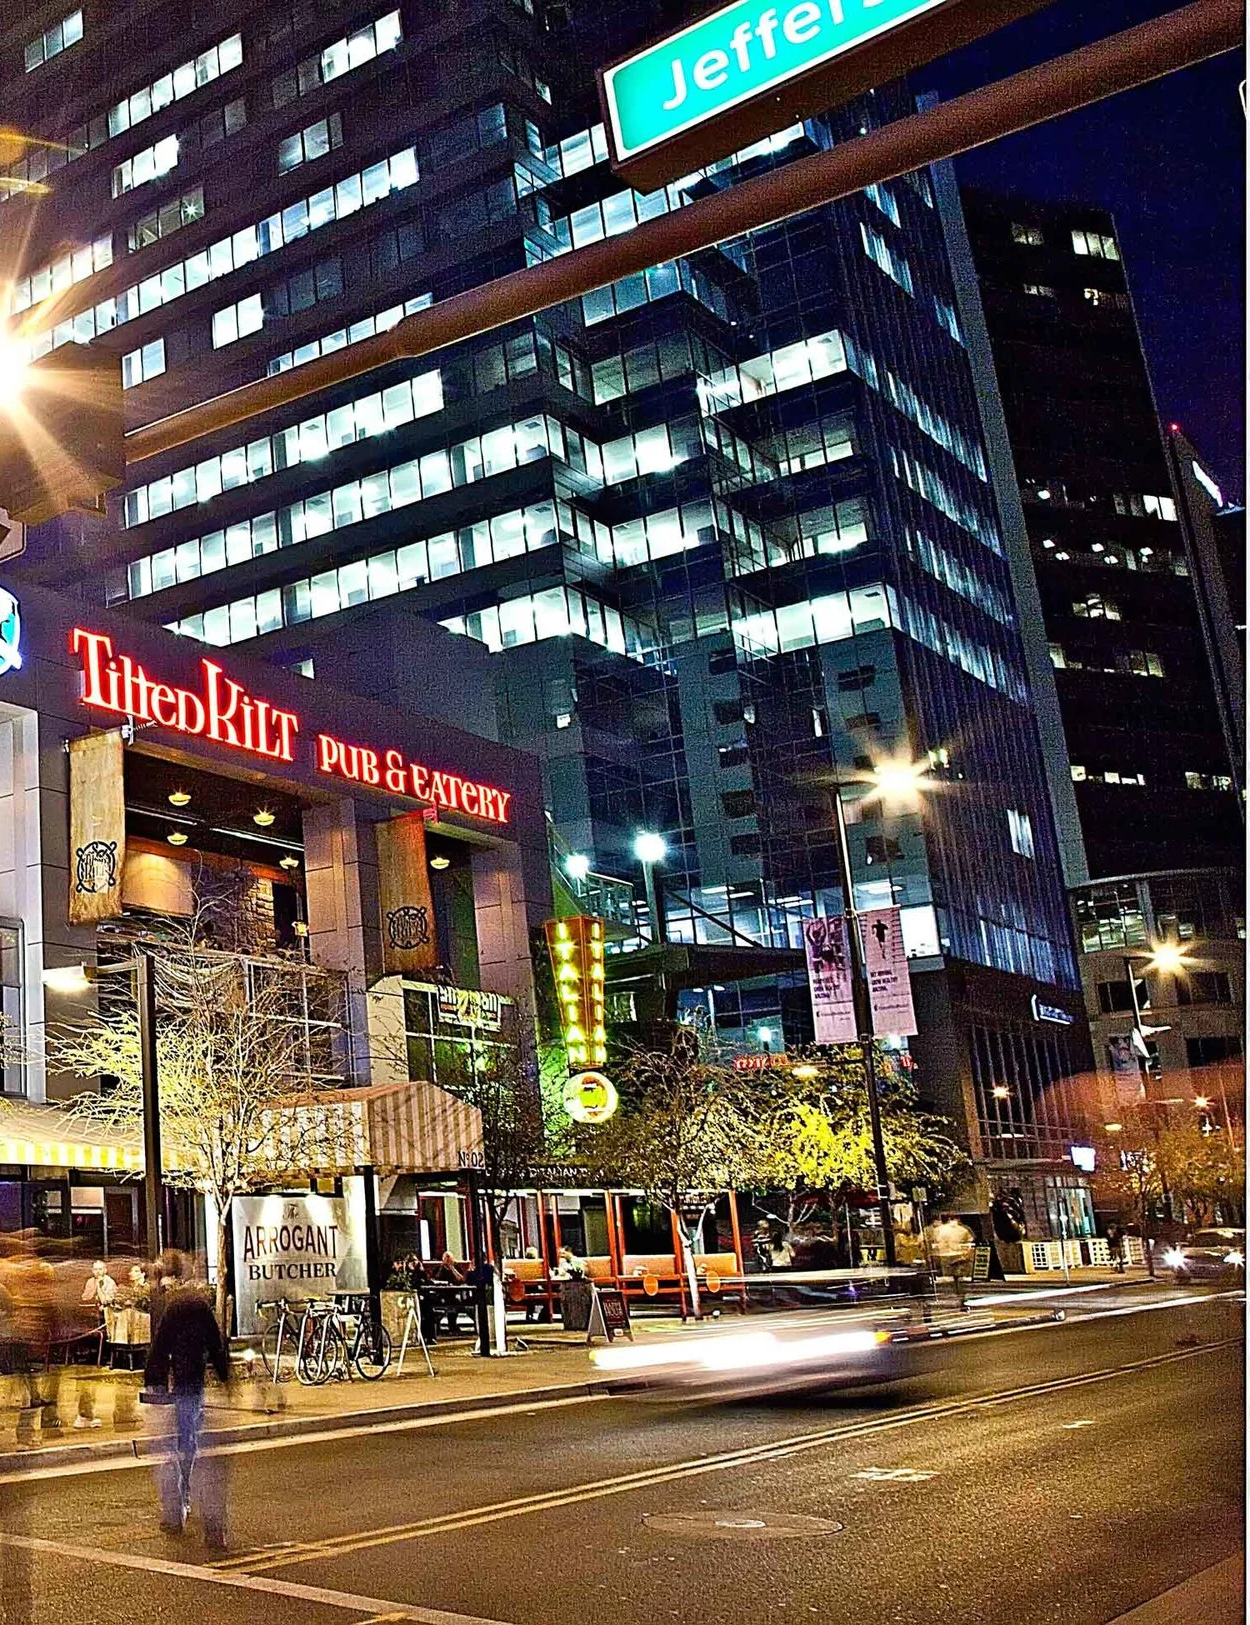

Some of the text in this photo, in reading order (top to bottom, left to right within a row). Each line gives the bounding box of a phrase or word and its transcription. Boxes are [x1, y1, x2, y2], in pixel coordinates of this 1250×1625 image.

[318, 734, 380, 785] PUB
[385, 750, 408, 794] &
[554, 921, 588, 1065] ITALIAN
[471, 1151, 484, 1168] 02
[243, 1225, 338, 1263] ARROGANT
[249, 1262, 337, 1281] BUTCHER
